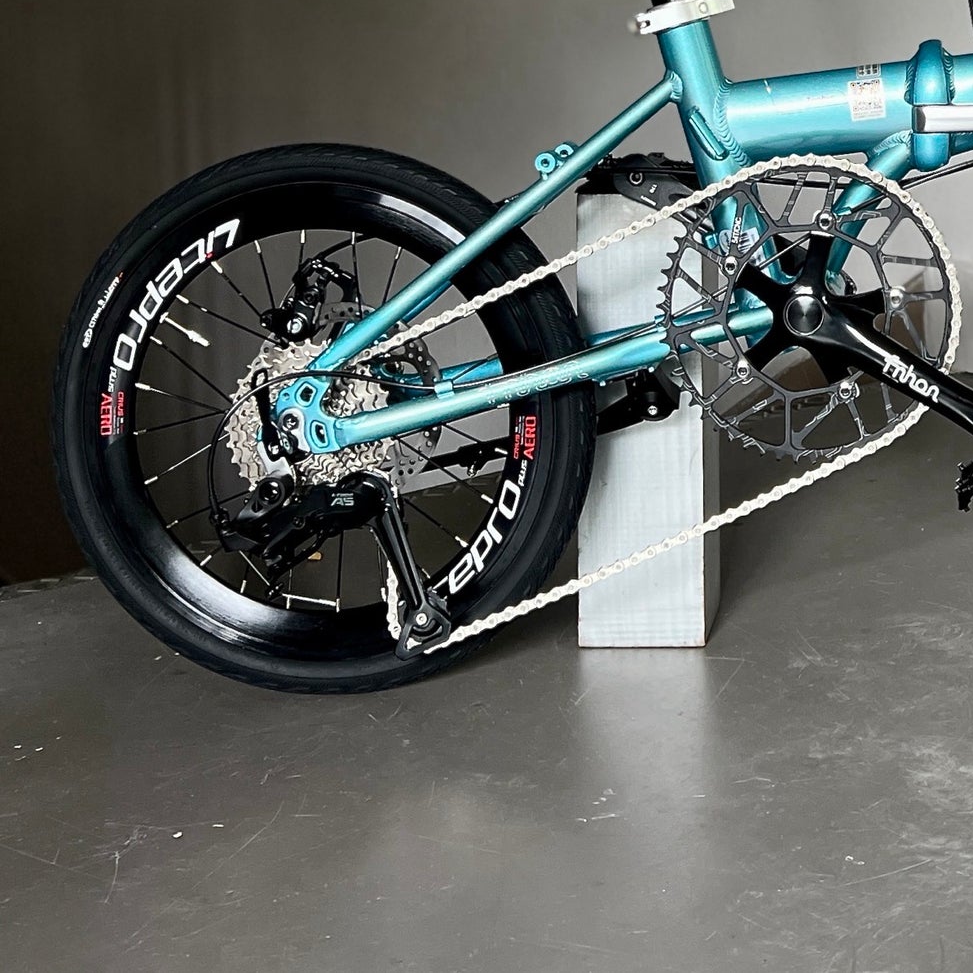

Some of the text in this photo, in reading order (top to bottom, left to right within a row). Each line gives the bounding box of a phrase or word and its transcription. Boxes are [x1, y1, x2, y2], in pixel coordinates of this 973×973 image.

[882, 354, 940, 404] fnhon
[101, 392, 113, 436] AERO
[523, 416, 537, 459] AERO
